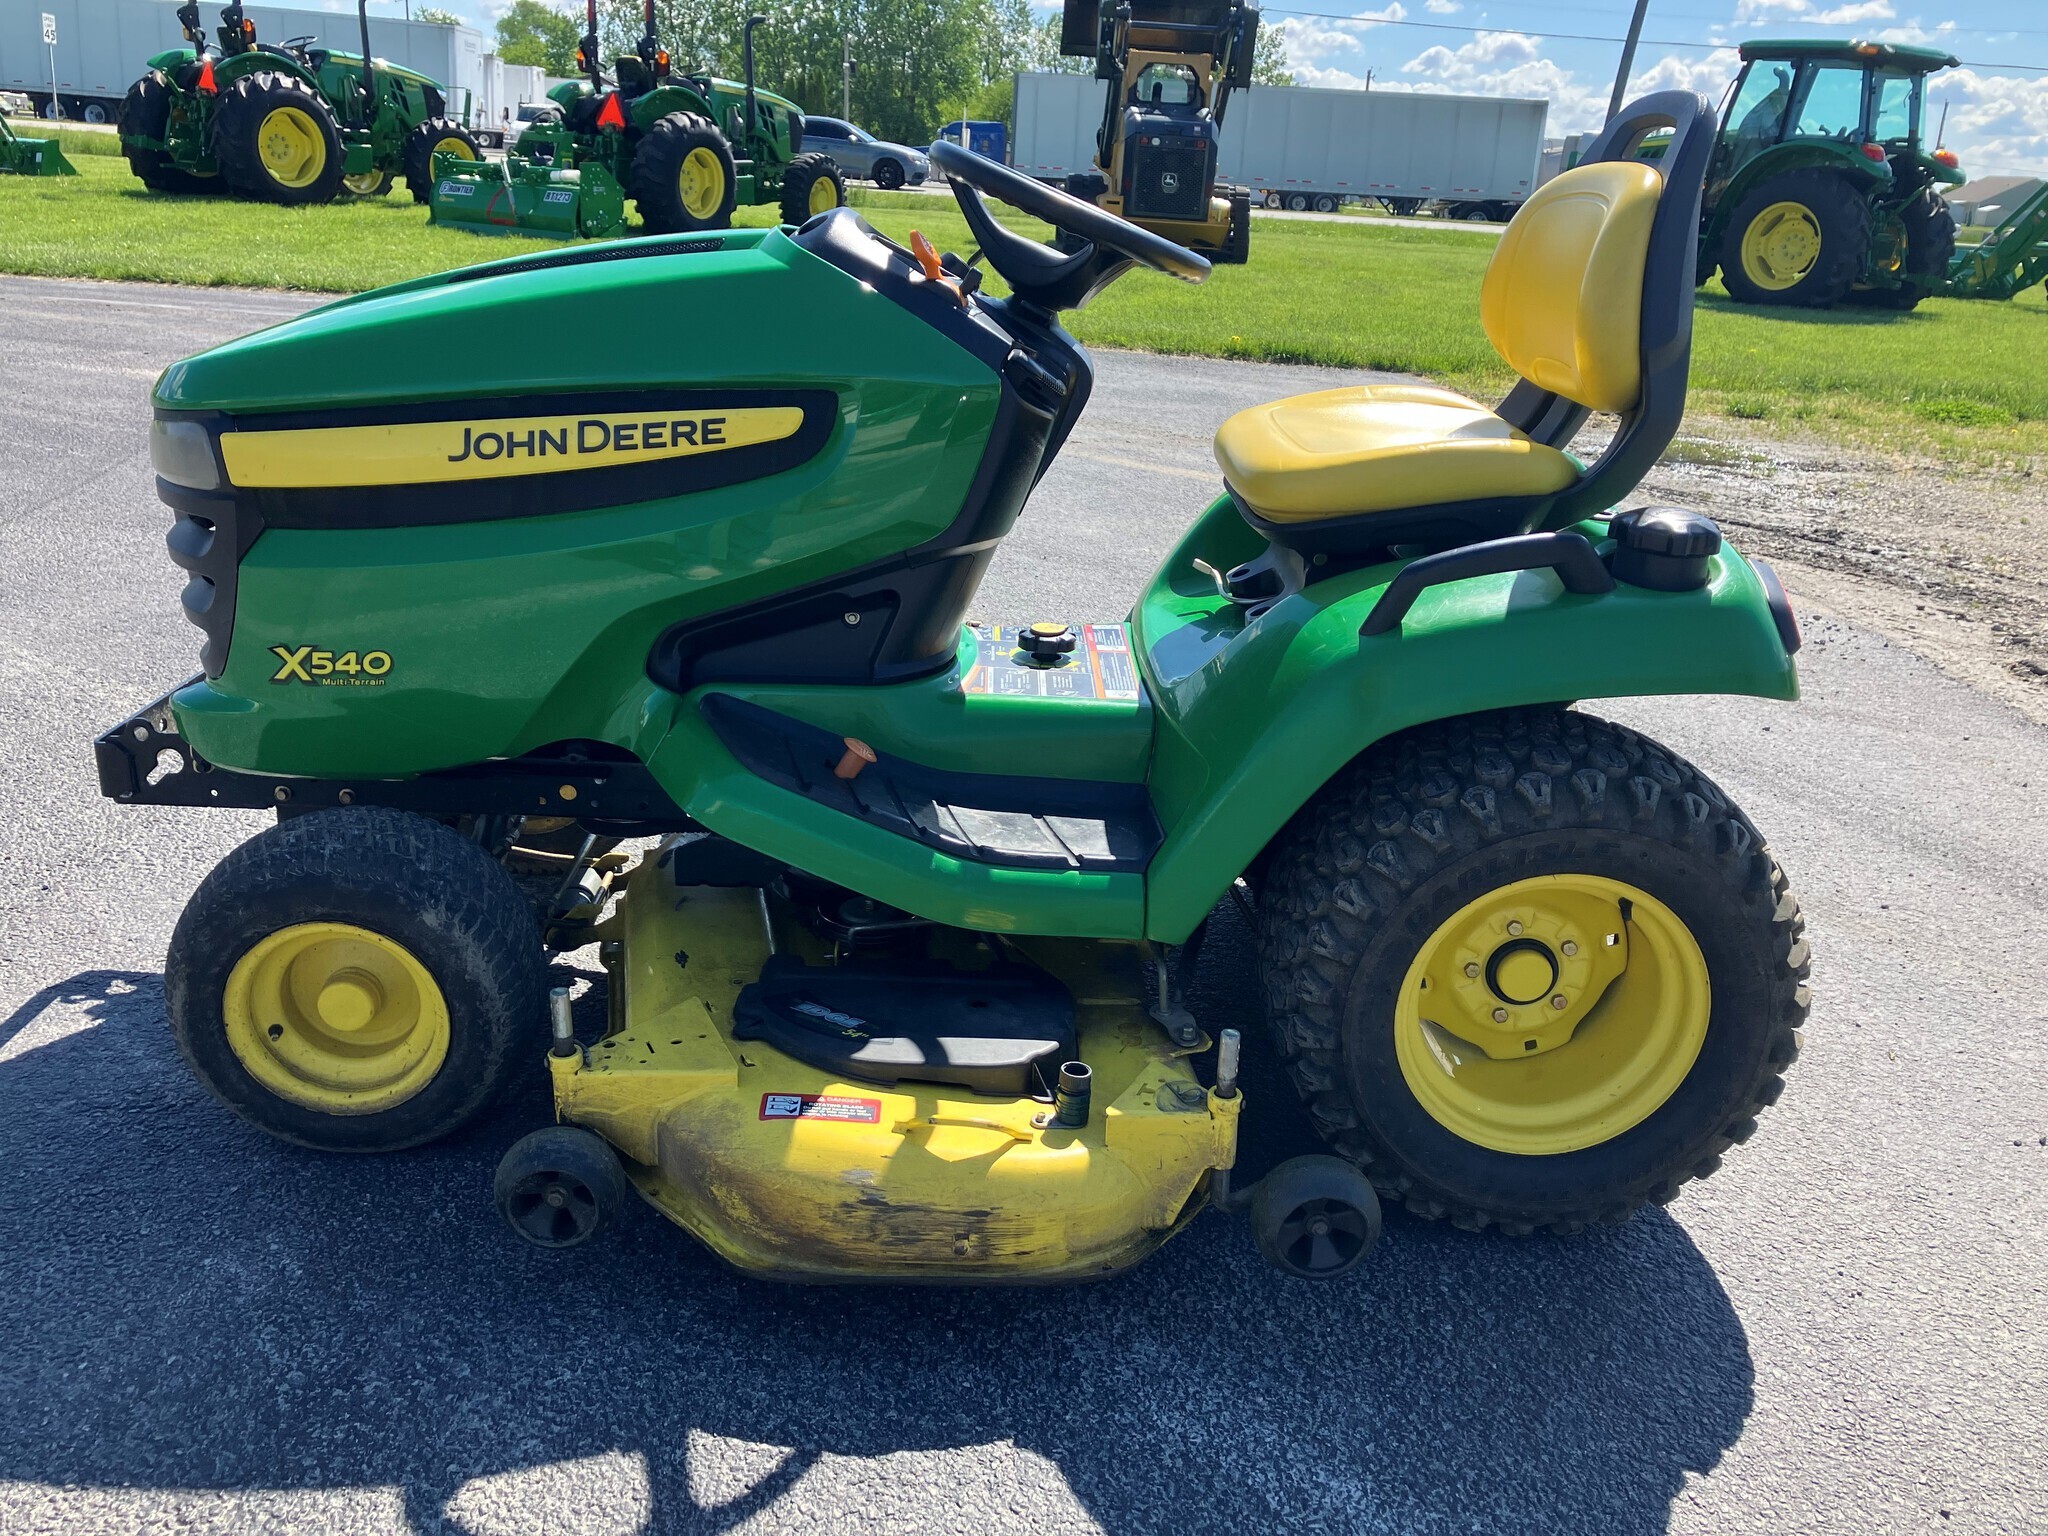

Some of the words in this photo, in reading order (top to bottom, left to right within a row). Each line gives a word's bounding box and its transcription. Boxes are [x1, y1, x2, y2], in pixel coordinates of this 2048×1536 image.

[44, 29, 56, 41] 45
[440, 181, 475, 196] FRONTIER
[447, 427, 568, 462] JOHN
[577, 417, 727, 454] DEERE
[269, 645, 393, 683] X540
[322, 678, 385, 686] Multi-Terrain
[789, 1001, 867, 1029] EDGE
